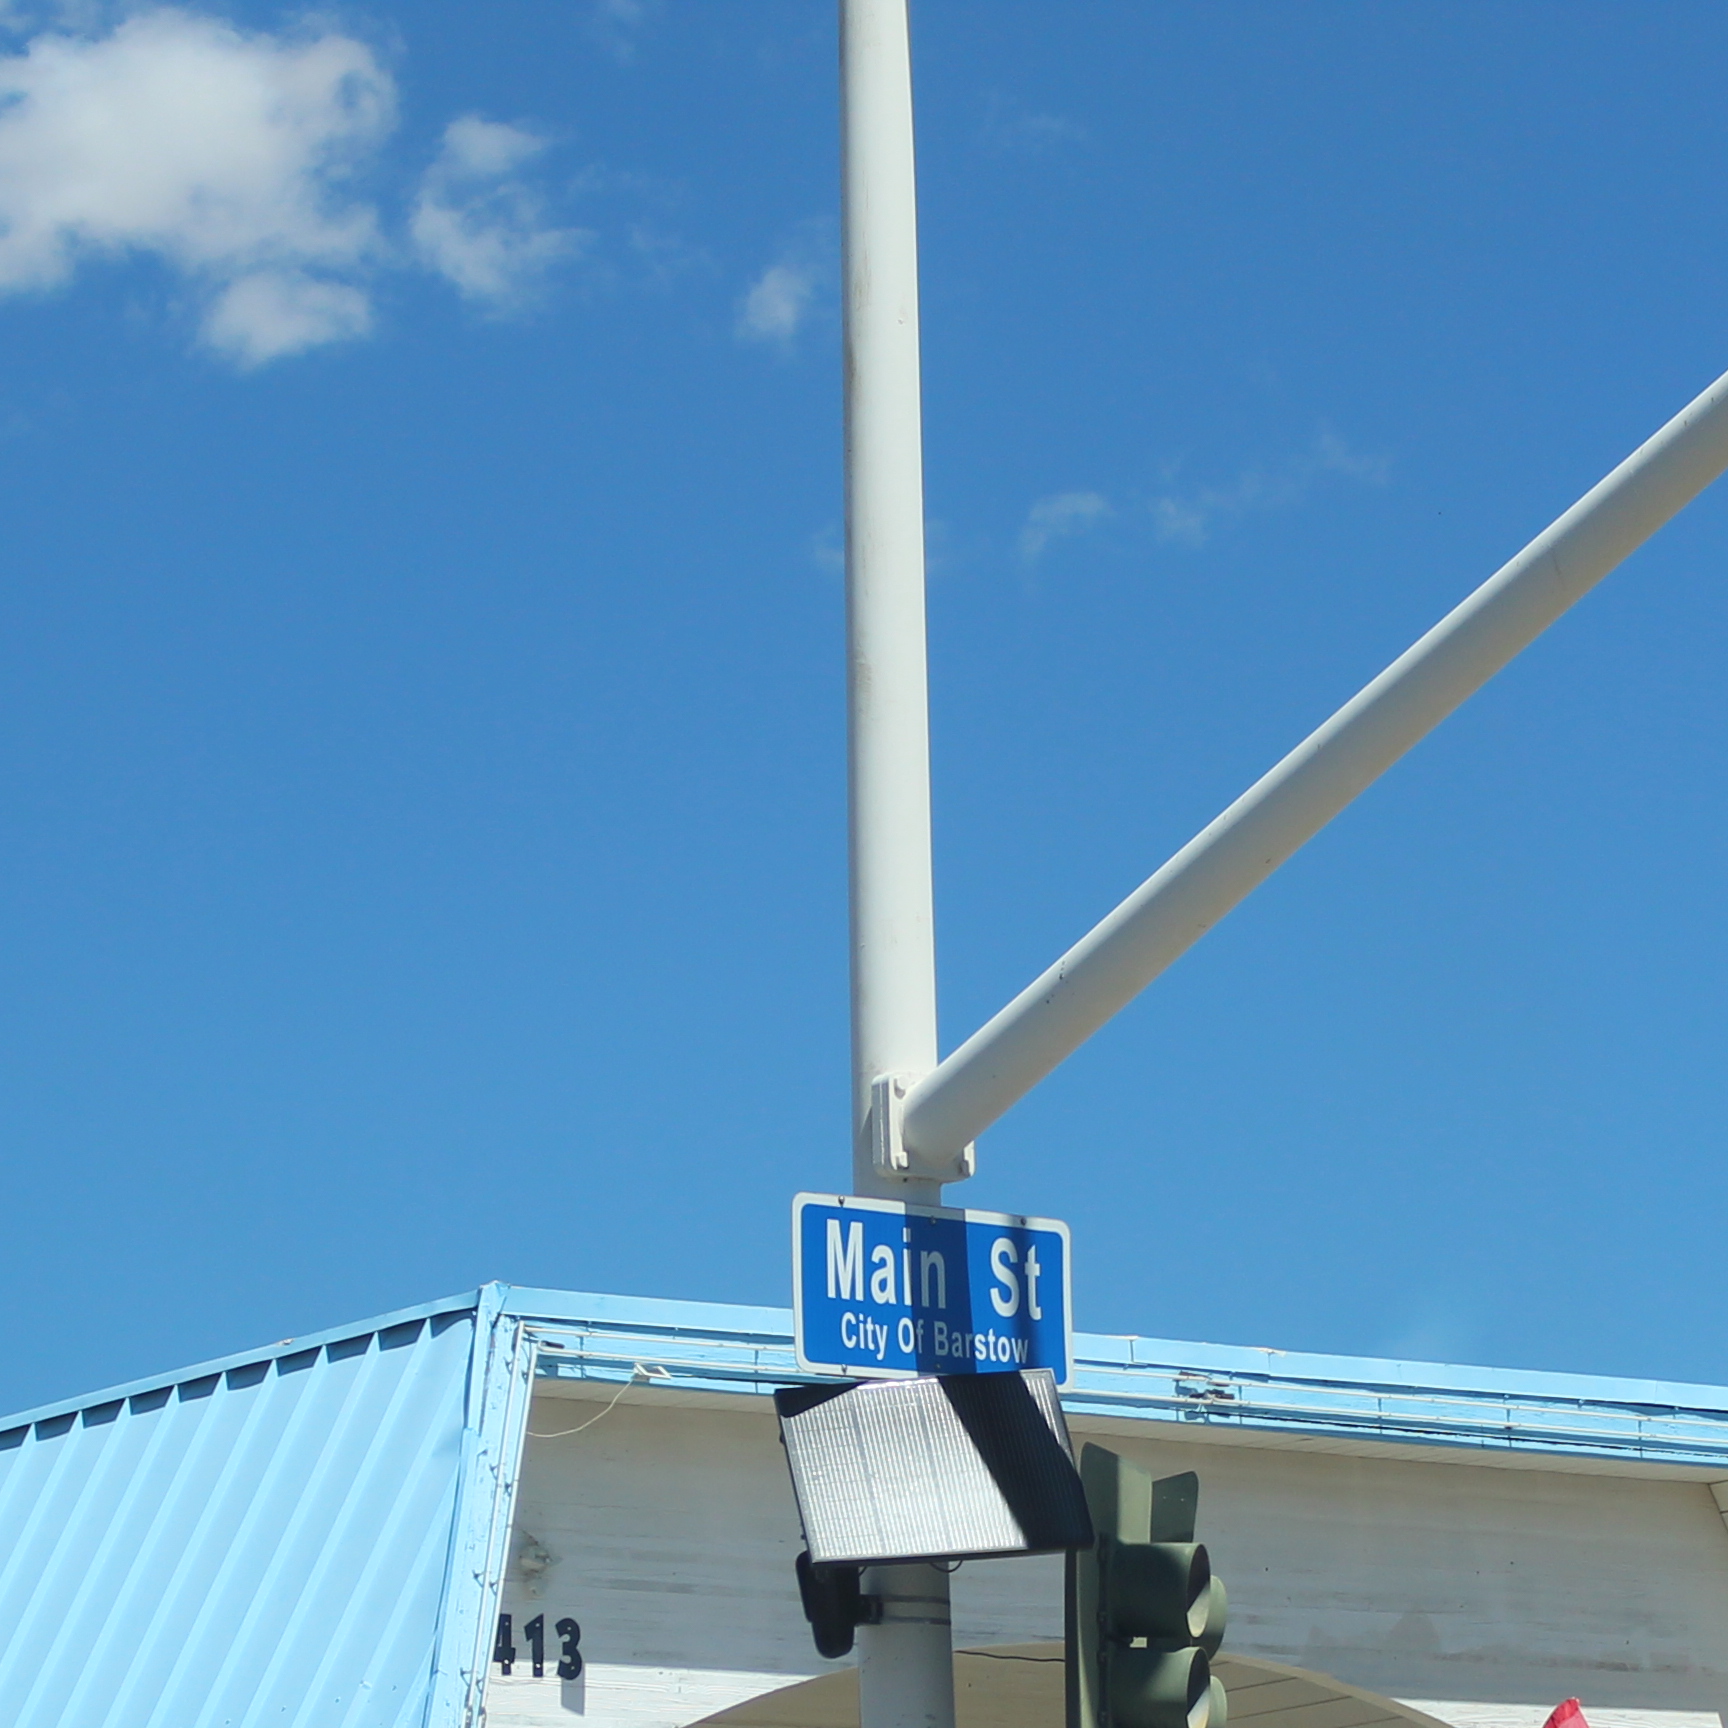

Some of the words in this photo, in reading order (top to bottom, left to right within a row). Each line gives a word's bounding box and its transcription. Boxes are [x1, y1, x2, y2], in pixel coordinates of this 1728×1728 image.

[826, 1218, 947, 1310] Main
[990, 1237, 1042, 1321] St
[841, 1311, 888, 1361] City
[897, 1316, 925, 1355] Of
[934, 1320, 1029, 1364] Barstow
[493, 1613, 583, 1681] 413
